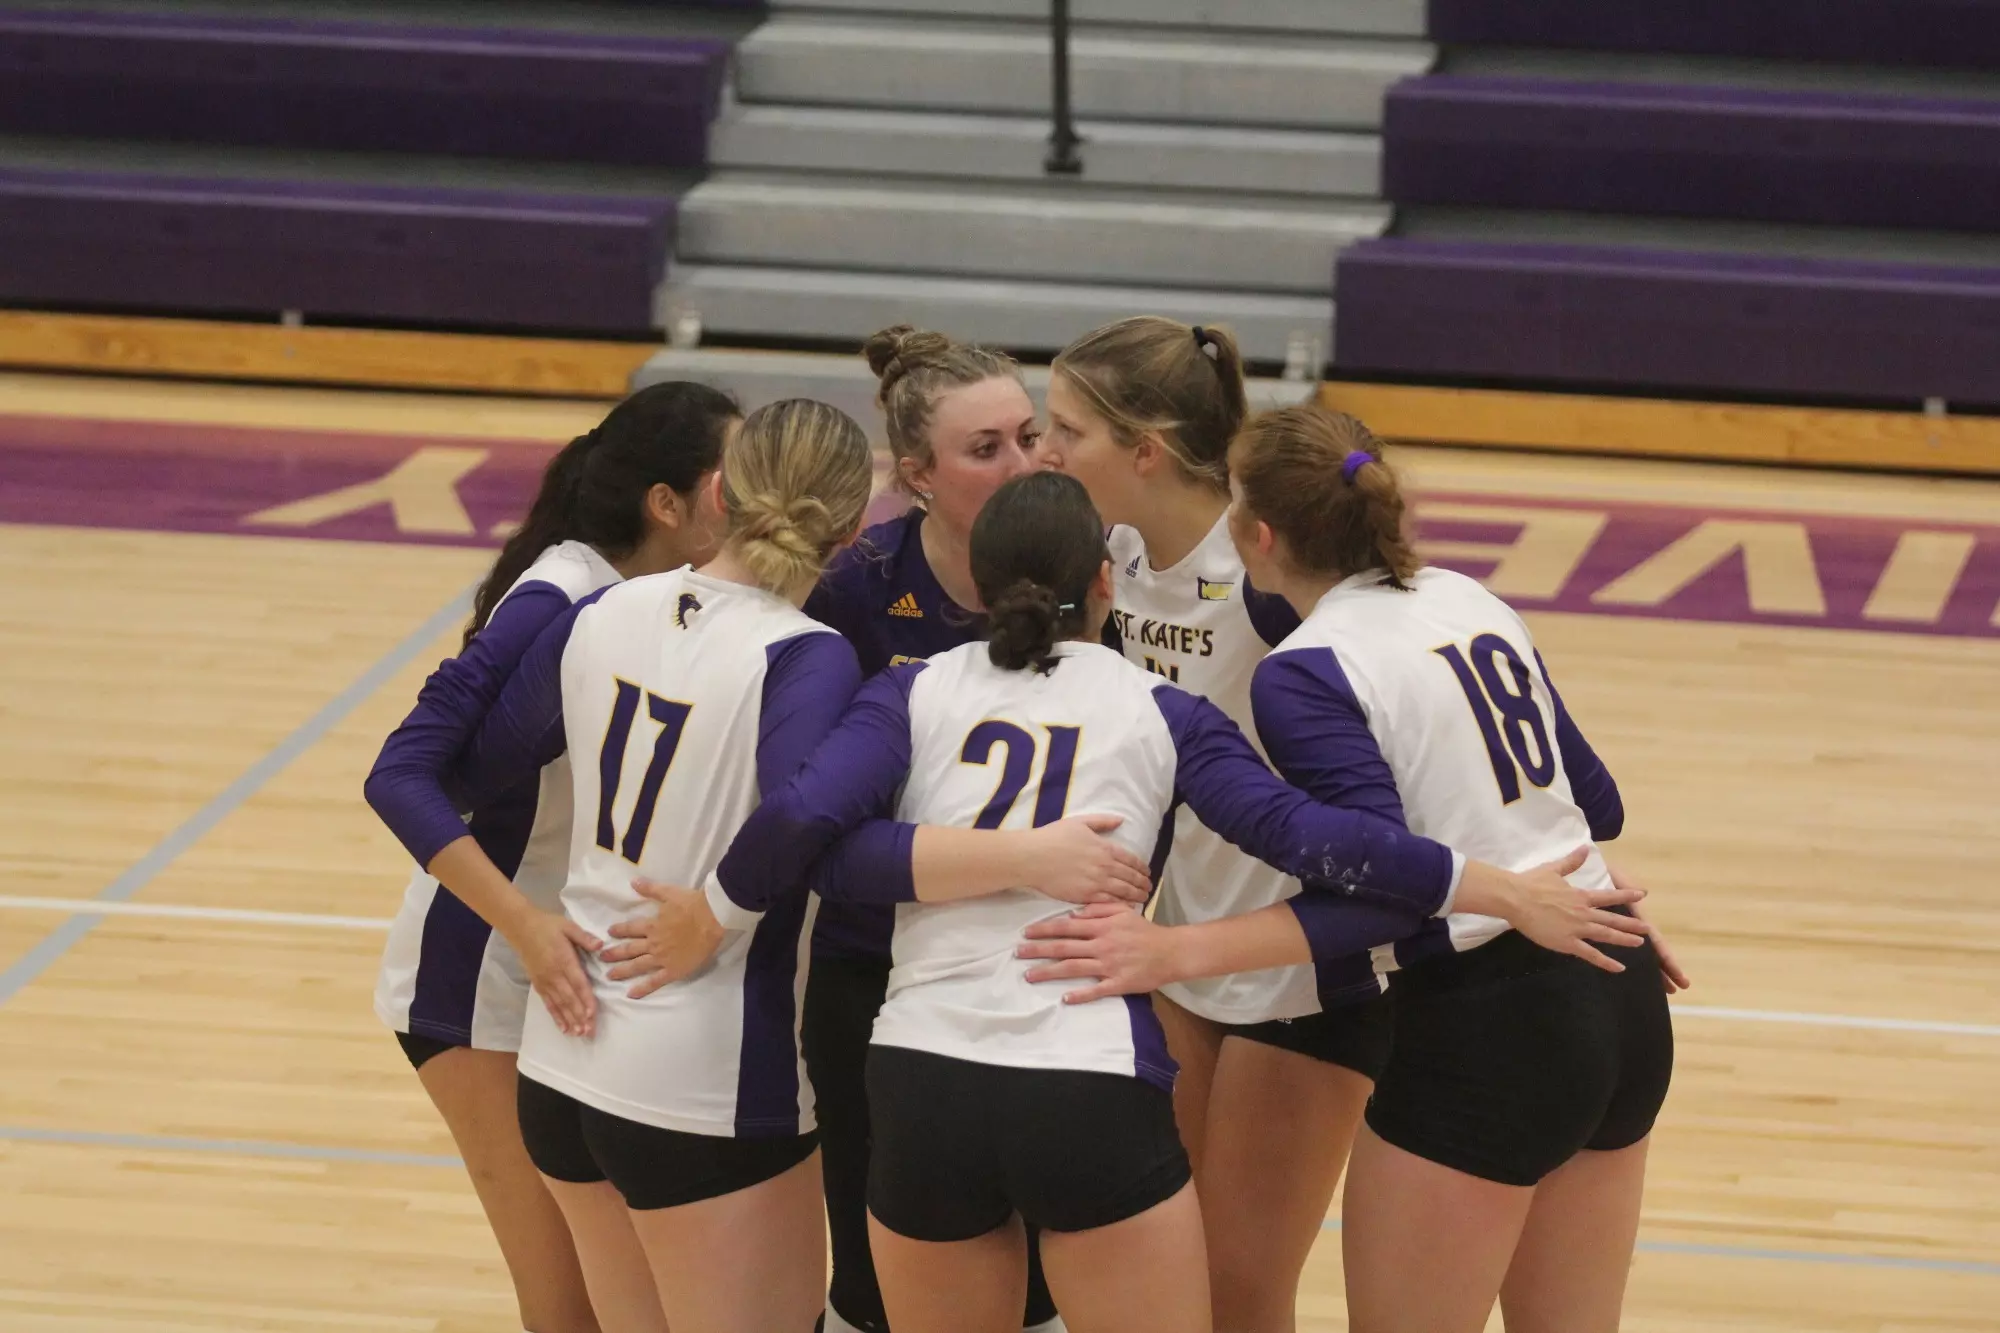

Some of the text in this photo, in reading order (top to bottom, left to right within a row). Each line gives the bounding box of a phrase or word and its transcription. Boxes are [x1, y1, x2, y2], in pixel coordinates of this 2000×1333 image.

[887, 607, 924, 618] adidas
[1113, 608, 1214, 657] ST. KATE'S
[595, 674, 695, 867] 17
[958, 716, 1083, 830] 21
[1427, 629, 1556, 807] 18
